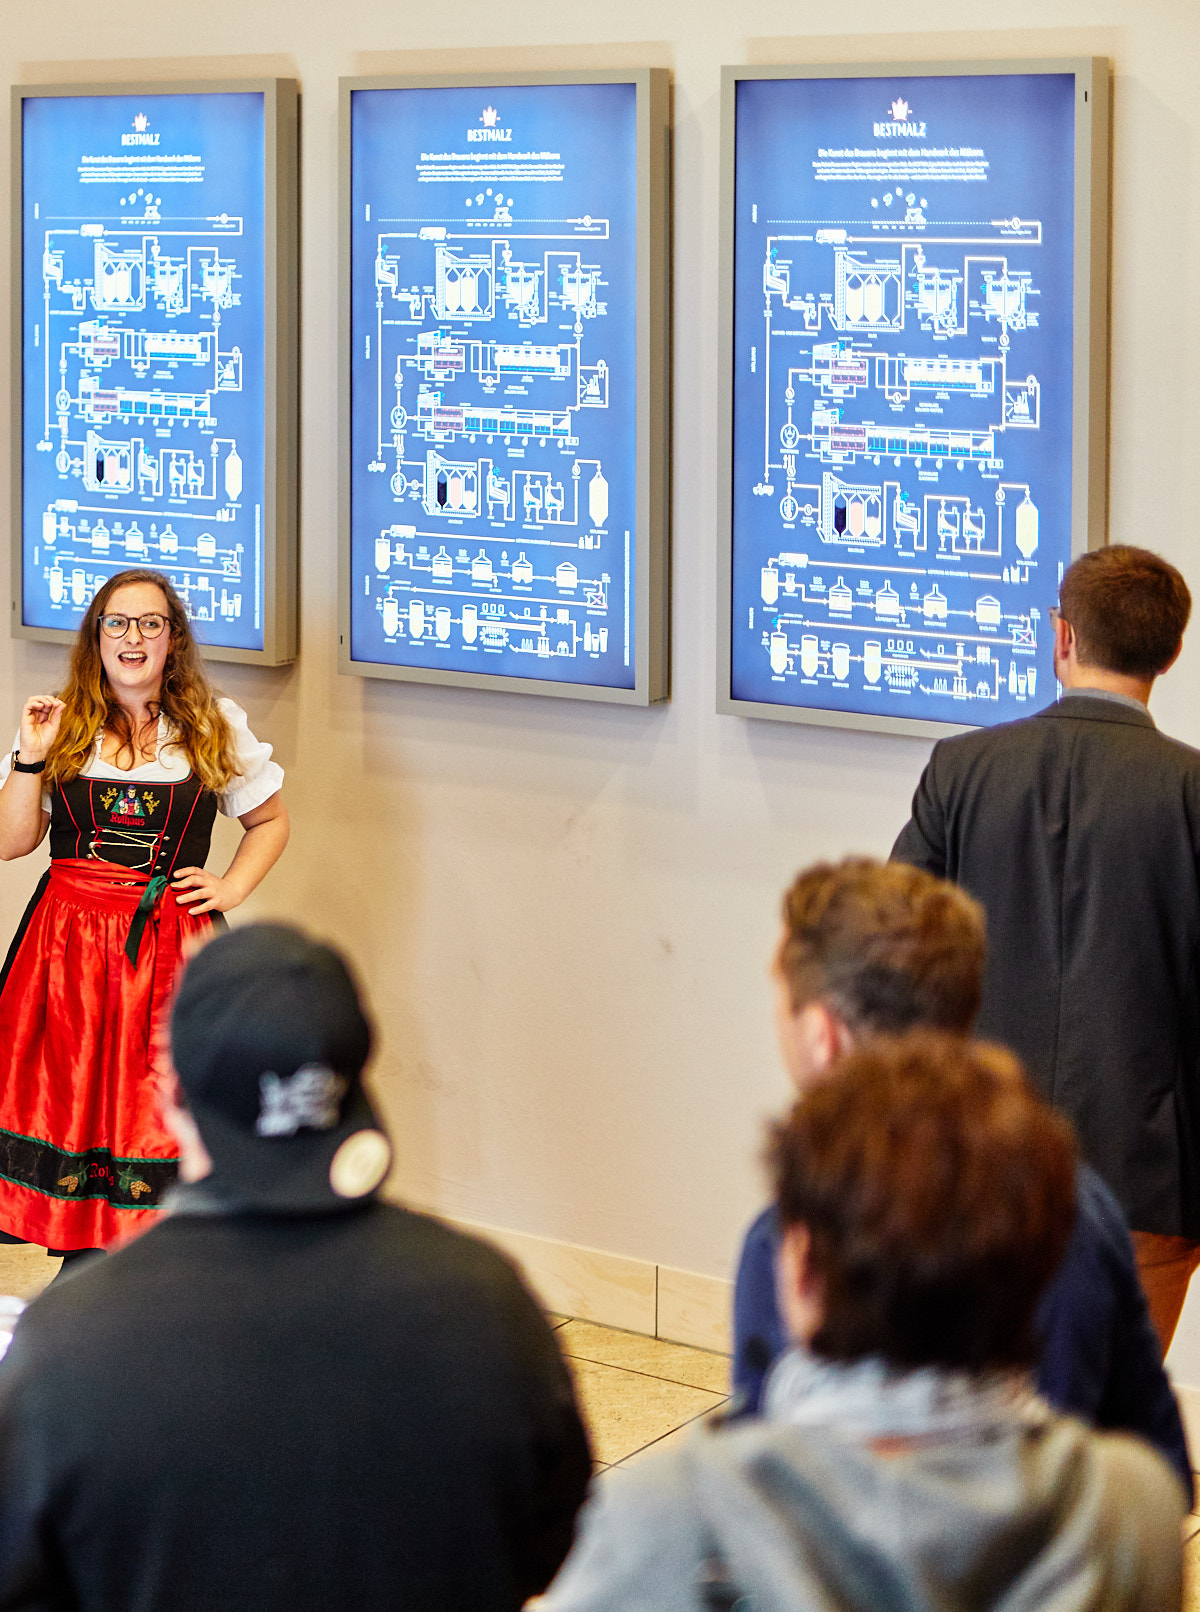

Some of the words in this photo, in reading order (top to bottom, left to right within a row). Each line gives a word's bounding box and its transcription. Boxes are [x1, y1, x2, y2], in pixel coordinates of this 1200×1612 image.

[467, 129, 513, 142] BESTMALZ
[873, 122, 927, 137] BESTMALZ
[110, 811, 145, 827] Rothaus
